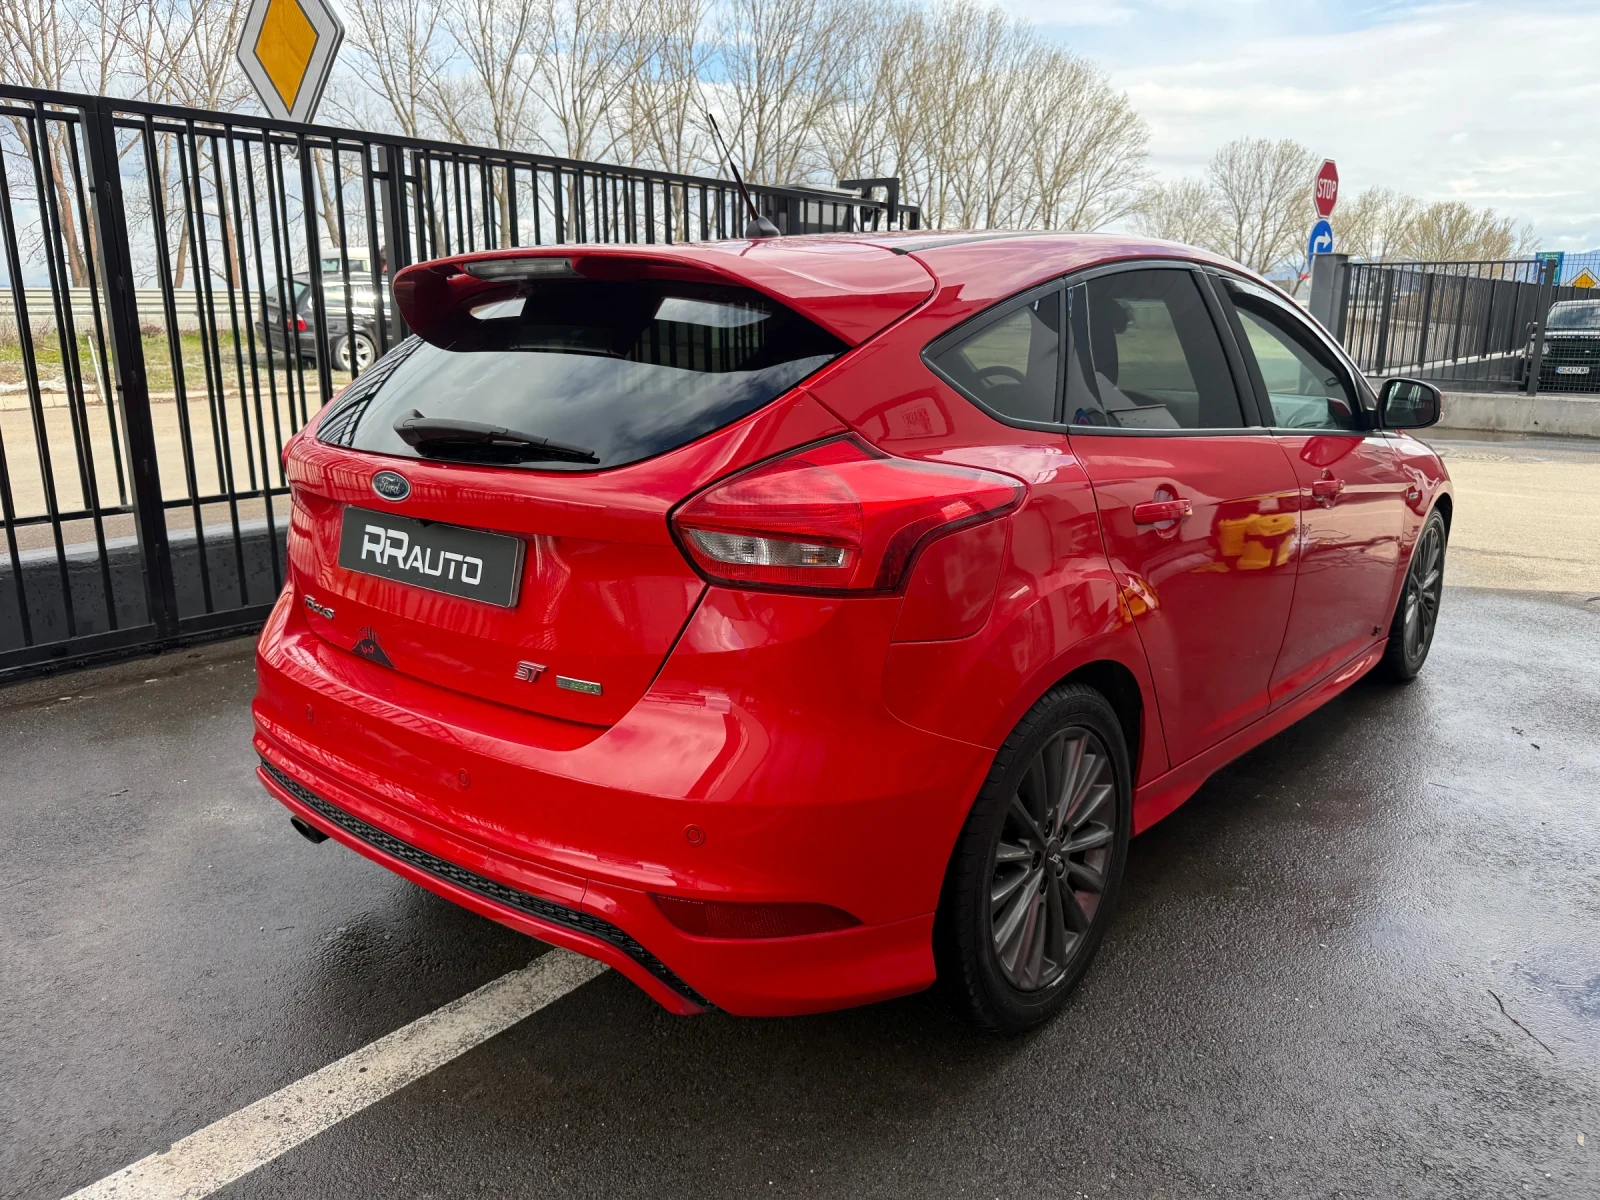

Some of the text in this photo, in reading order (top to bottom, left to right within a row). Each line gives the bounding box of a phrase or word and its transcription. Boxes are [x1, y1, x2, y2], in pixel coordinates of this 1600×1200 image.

[1317, 178, 1337, 200] STOP
[380, 476, 401, 494] Ford
[514, 660, 548, 682] ST
